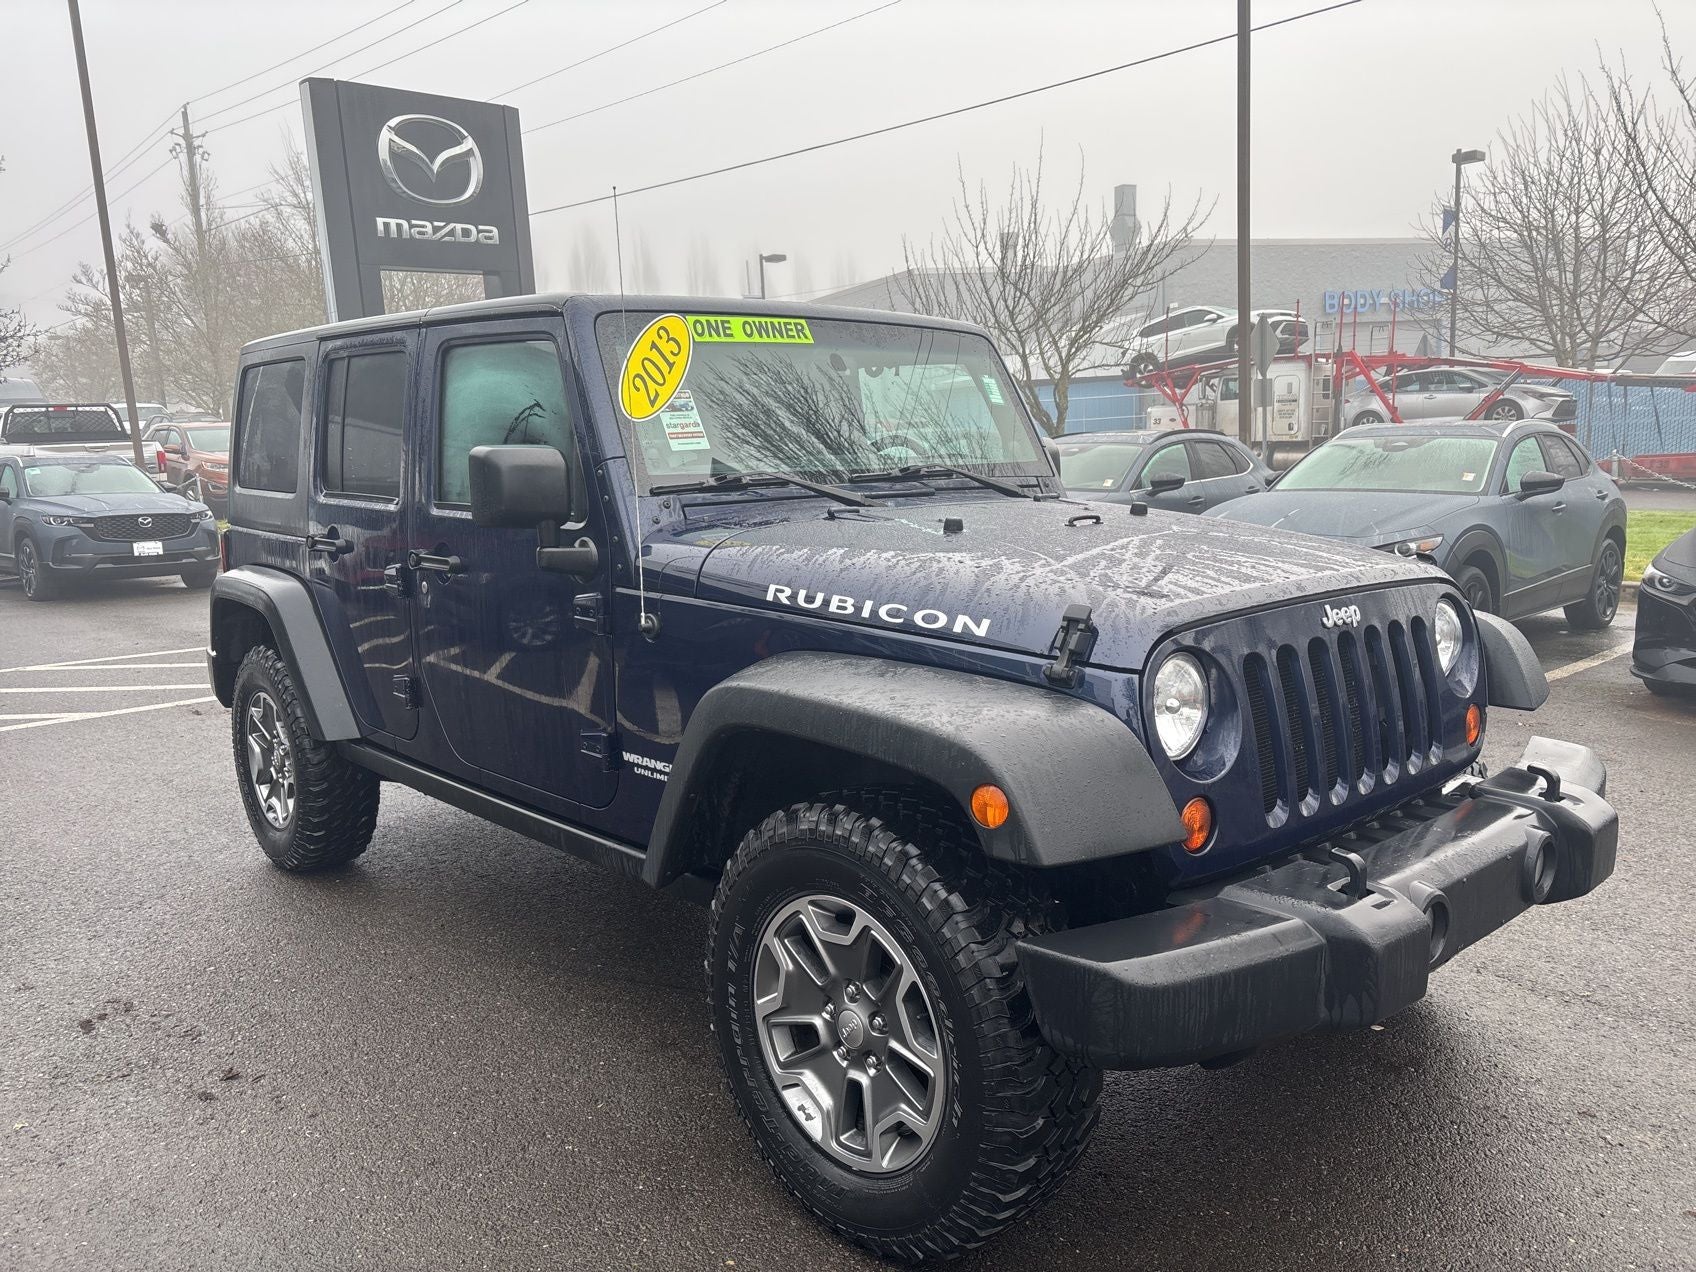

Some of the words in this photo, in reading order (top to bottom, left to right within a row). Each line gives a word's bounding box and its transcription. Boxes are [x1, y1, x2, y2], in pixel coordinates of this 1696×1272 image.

[376, 217, 500, 245] mazda
[1324, 290, 1383, 314] BODY
[693, 319, 734, 338] ONE
[742, 320, 809, 340] OWNER
[632, 325, 682, 408] 2013
[1152, 417, 1162, 425] 33
[765, 583, 992, 638] RUBICON
[1321, 604, 1361, 629] Jeep
[633, 766, 670, 782] UNLIMI
